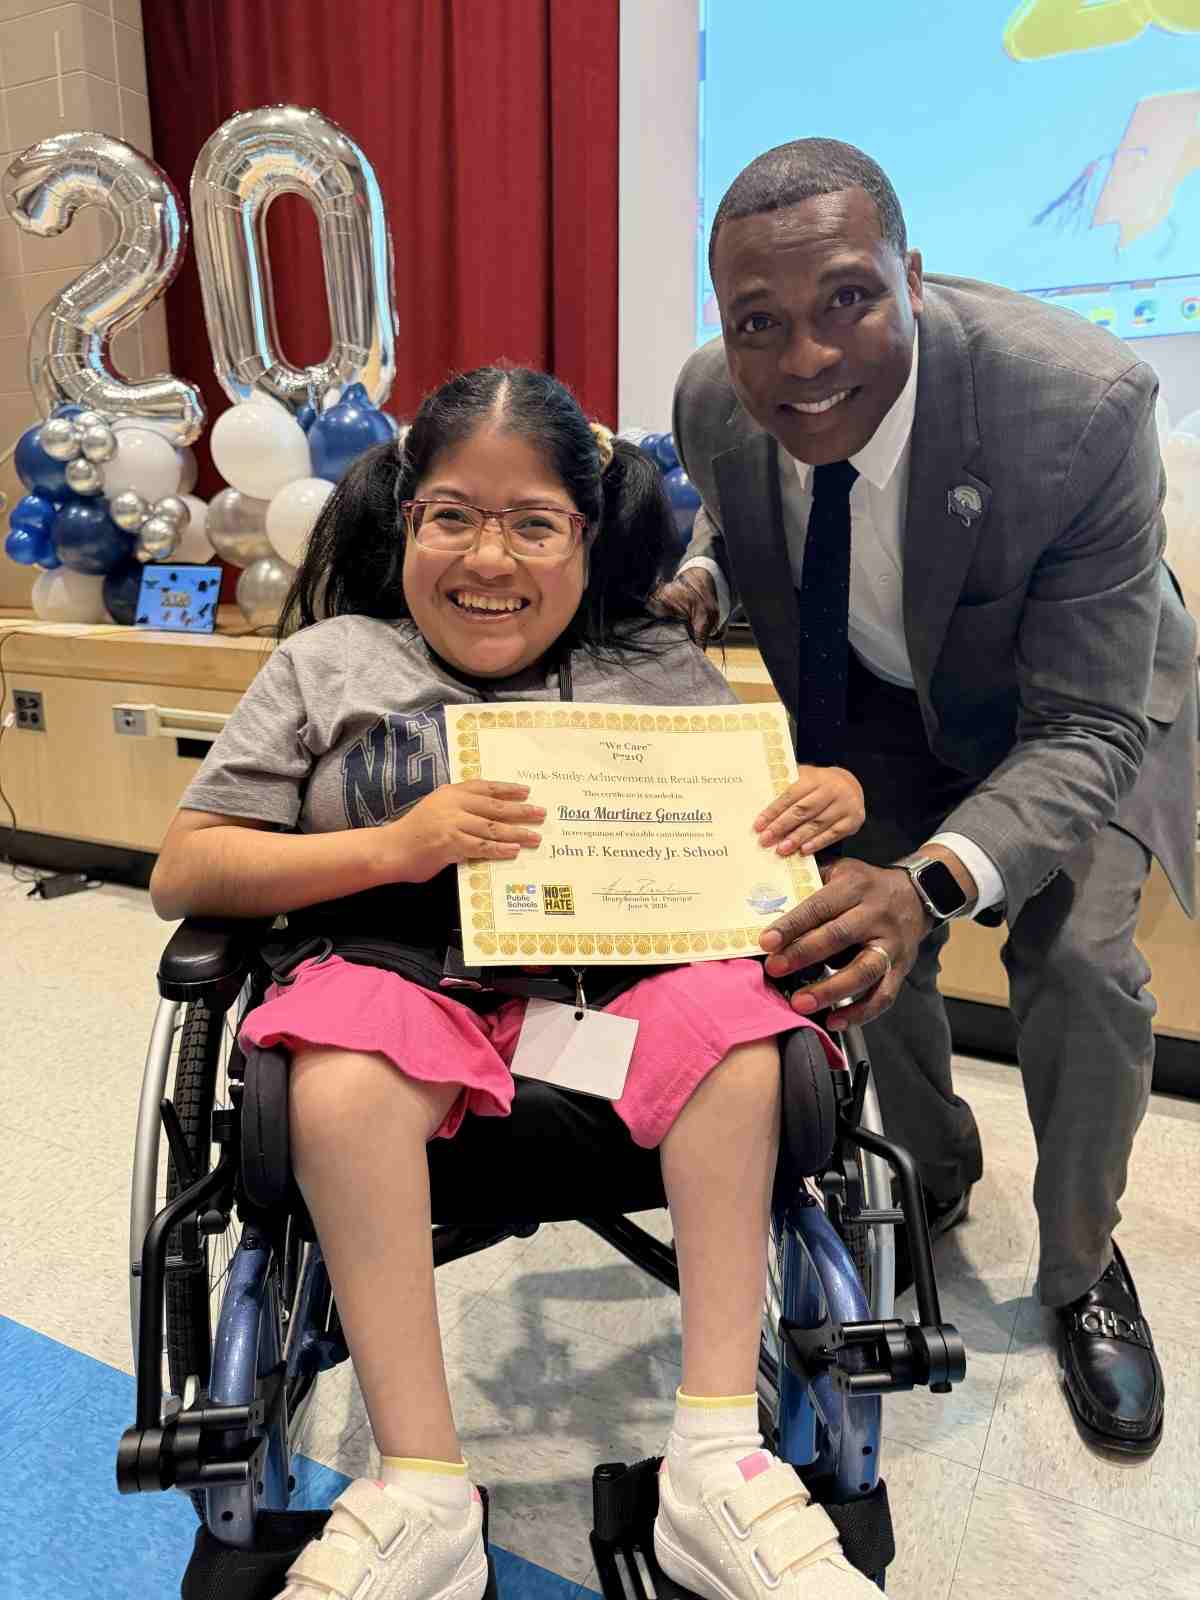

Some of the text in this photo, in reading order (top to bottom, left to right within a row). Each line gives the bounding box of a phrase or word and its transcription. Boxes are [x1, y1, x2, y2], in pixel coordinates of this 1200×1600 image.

[588, 771, 654, 784] Achievement
[701, 776, 744, 784] Services
[557, 805, 712, 823] Rosa Martinez Gonzales
[549, 845, 728, 860] John F. Kennedy Jr. School
[545, 899, 573, 910] HATE
